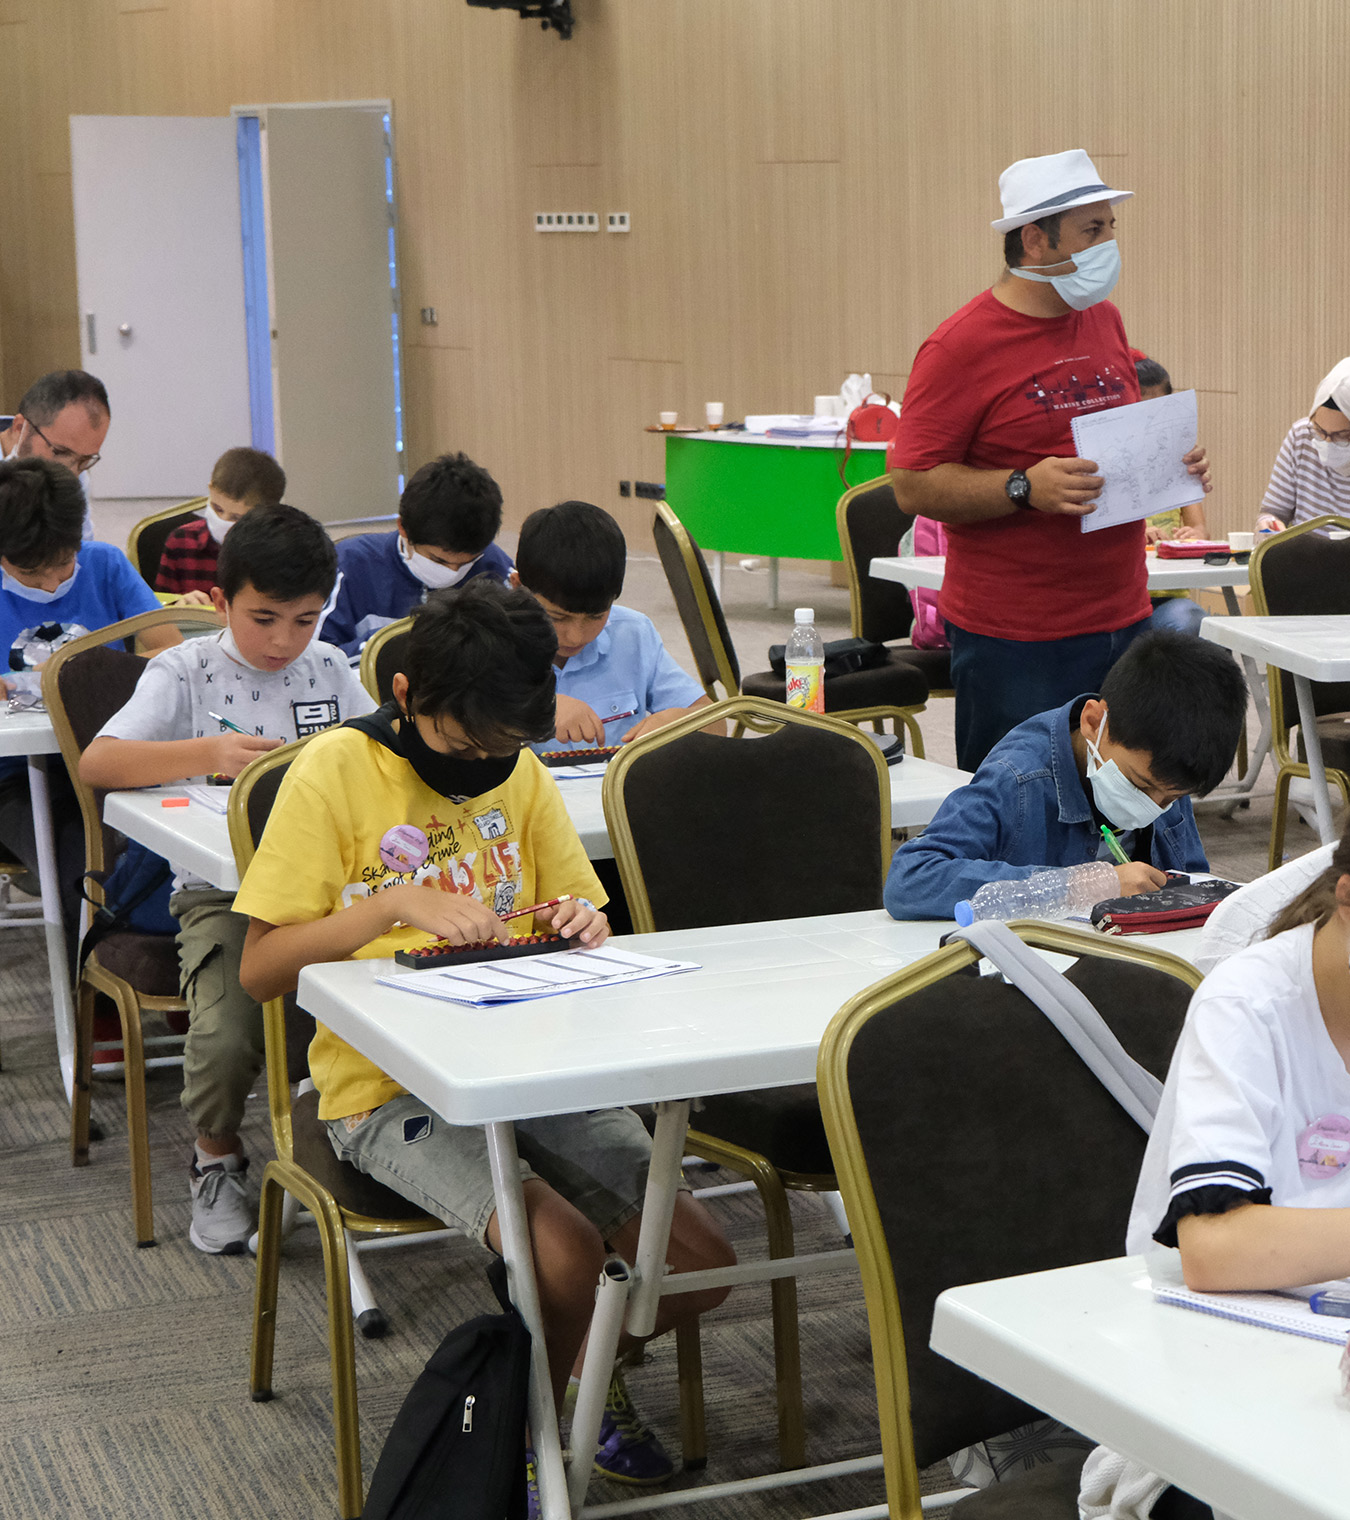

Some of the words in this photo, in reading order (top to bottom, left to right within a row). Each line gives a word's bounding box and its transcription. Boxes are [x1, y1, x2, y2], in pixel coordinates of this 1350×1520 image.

[200, 658, 209, 669] U
[323, 656, 333, 668] M
[205, 673, 213, 684] X
[283, 675, 291, 687] C
[308, 678, 316, 689] P
[224, 694, 233, 705] N
[251, 690, 260, 702] U
[330, 703, 338, 721] YOU
[255, 725, 264, 736] N
